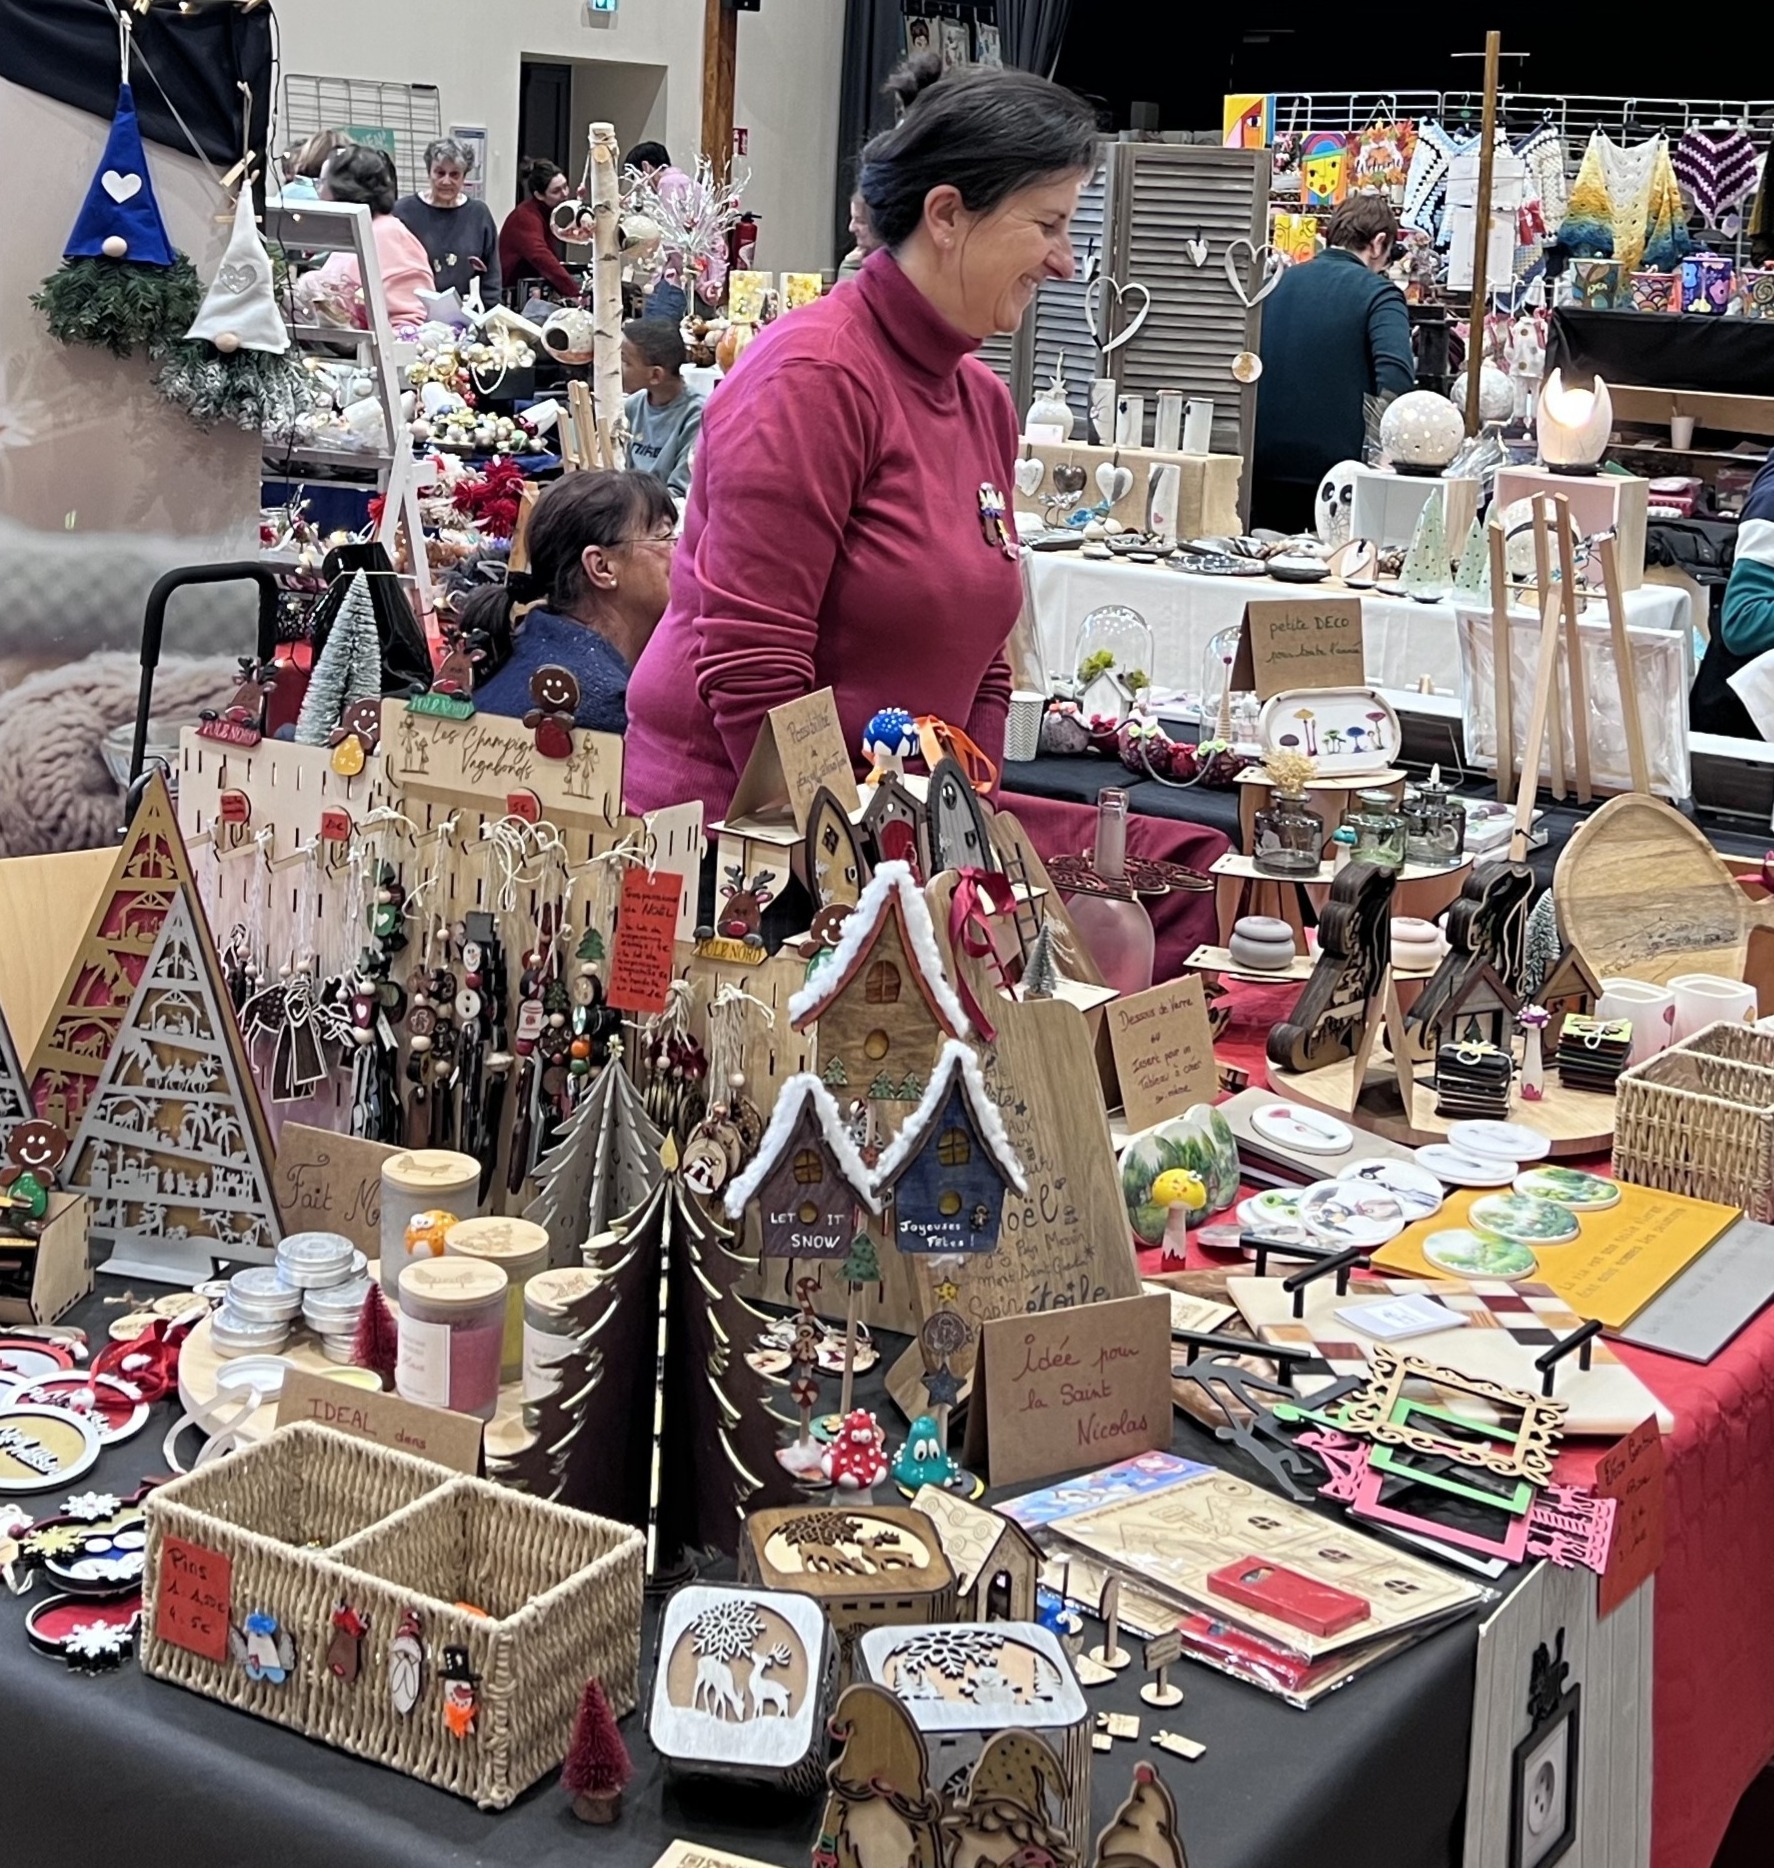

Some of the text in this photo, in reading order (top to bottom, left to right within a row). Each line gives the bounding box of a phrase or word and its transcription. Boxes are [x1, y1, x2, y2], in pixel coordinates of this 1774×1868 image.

[1269, 614, 1309, 639] petite
[431, 720, 460, 745] Les
[460, 747, 535, 784] Vagabonds
[729, 943, 762, 963] NORD
[1118, 994, 1194, 1032] Dessous de Verre
[1164, 1047, 1180, 1066] pour
[280, 1153, 334, 1211] Fait
[770, 1212, 845, 1226] LET IT
[1000, 1182, 1059, 1237] oël
[790, 1233, 841, 1249] SNOW
[900, 1219, 961, 1236] Joyeuses
[1091, 1346, 1139, 1374] pour
[1019, 1378, 1112, 1412] la Saint
[303, 1398, 427, 1451] IDEAL dans
[1077, 1408, 1148, 1446] Nicolas
[167, 1547, 207, 1580] Pins
